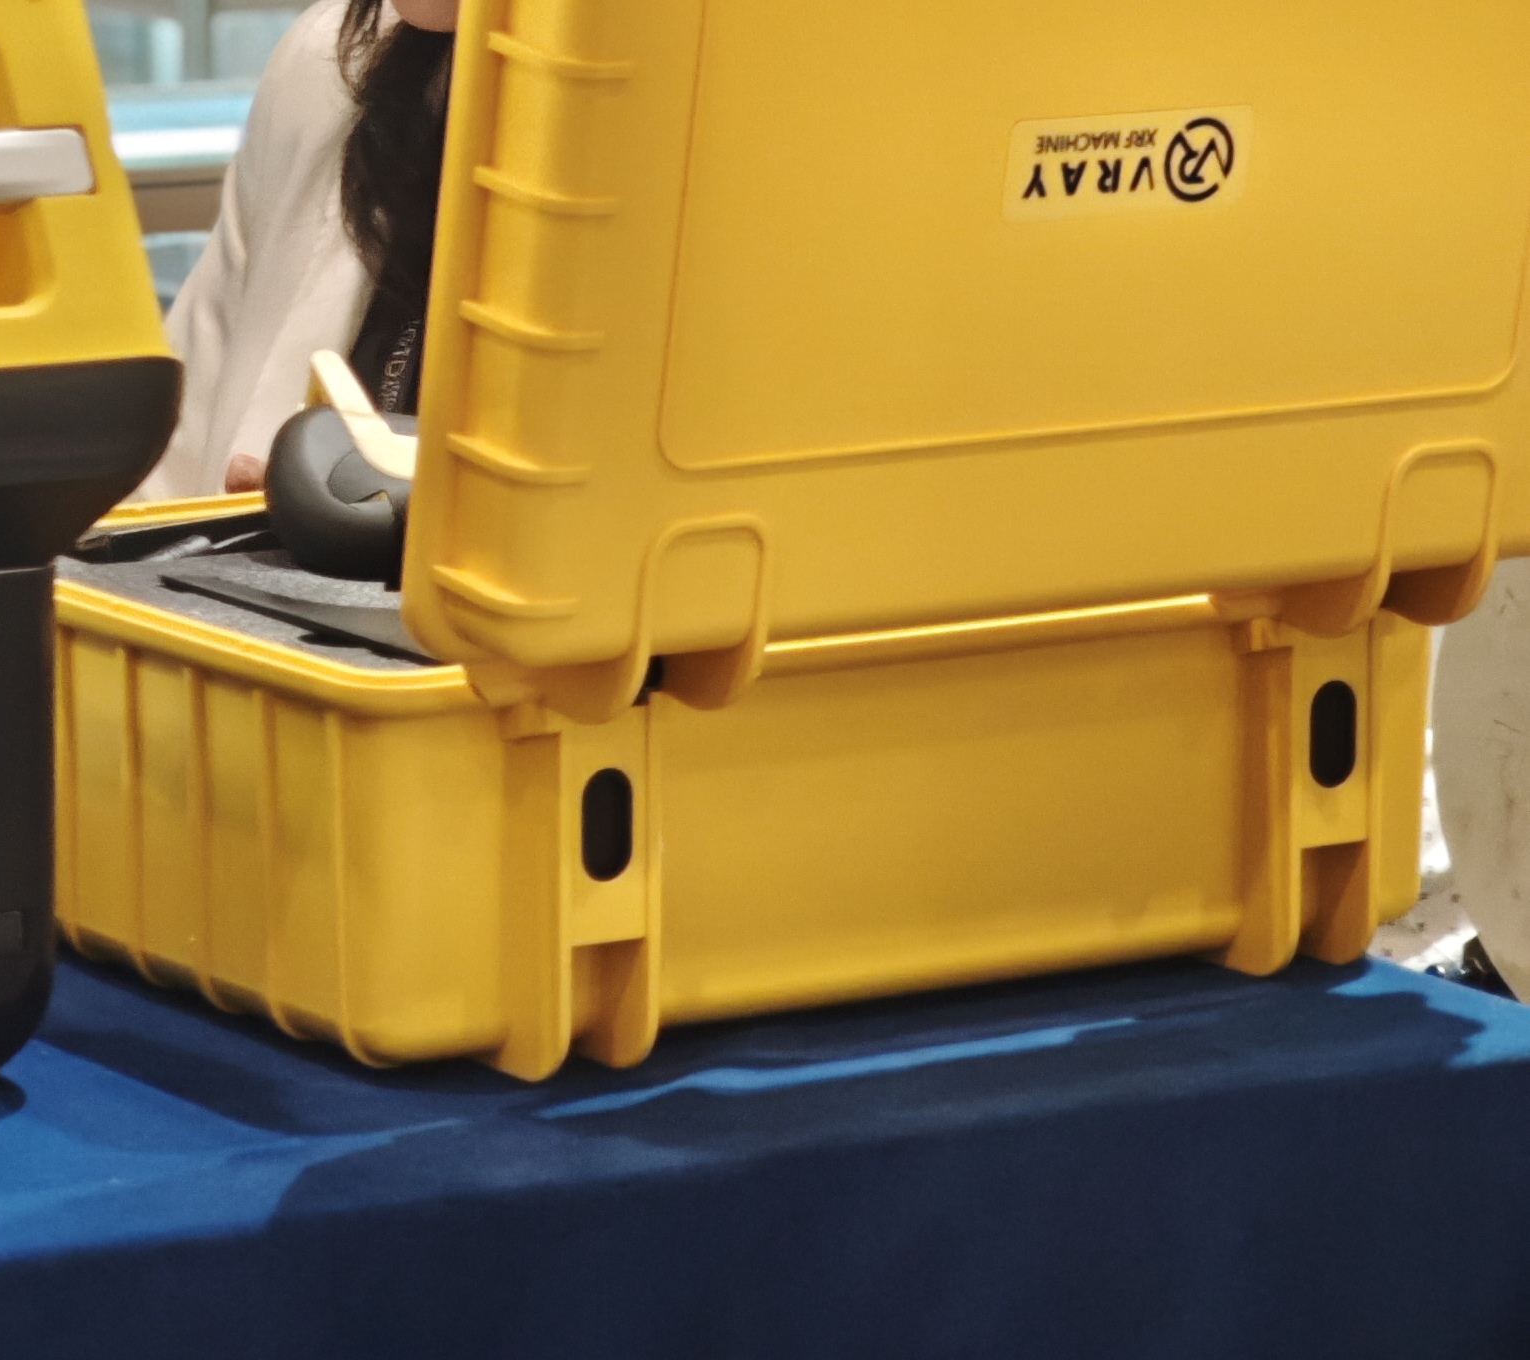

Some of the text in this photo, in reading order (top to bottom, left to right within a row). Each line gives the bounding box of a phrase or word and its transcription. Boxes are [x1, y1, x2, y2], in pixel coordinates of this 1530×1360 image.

[1035, 128, 1159, 155] XRF MACHINE
[1021, 157, 1156, 199] VRAY
